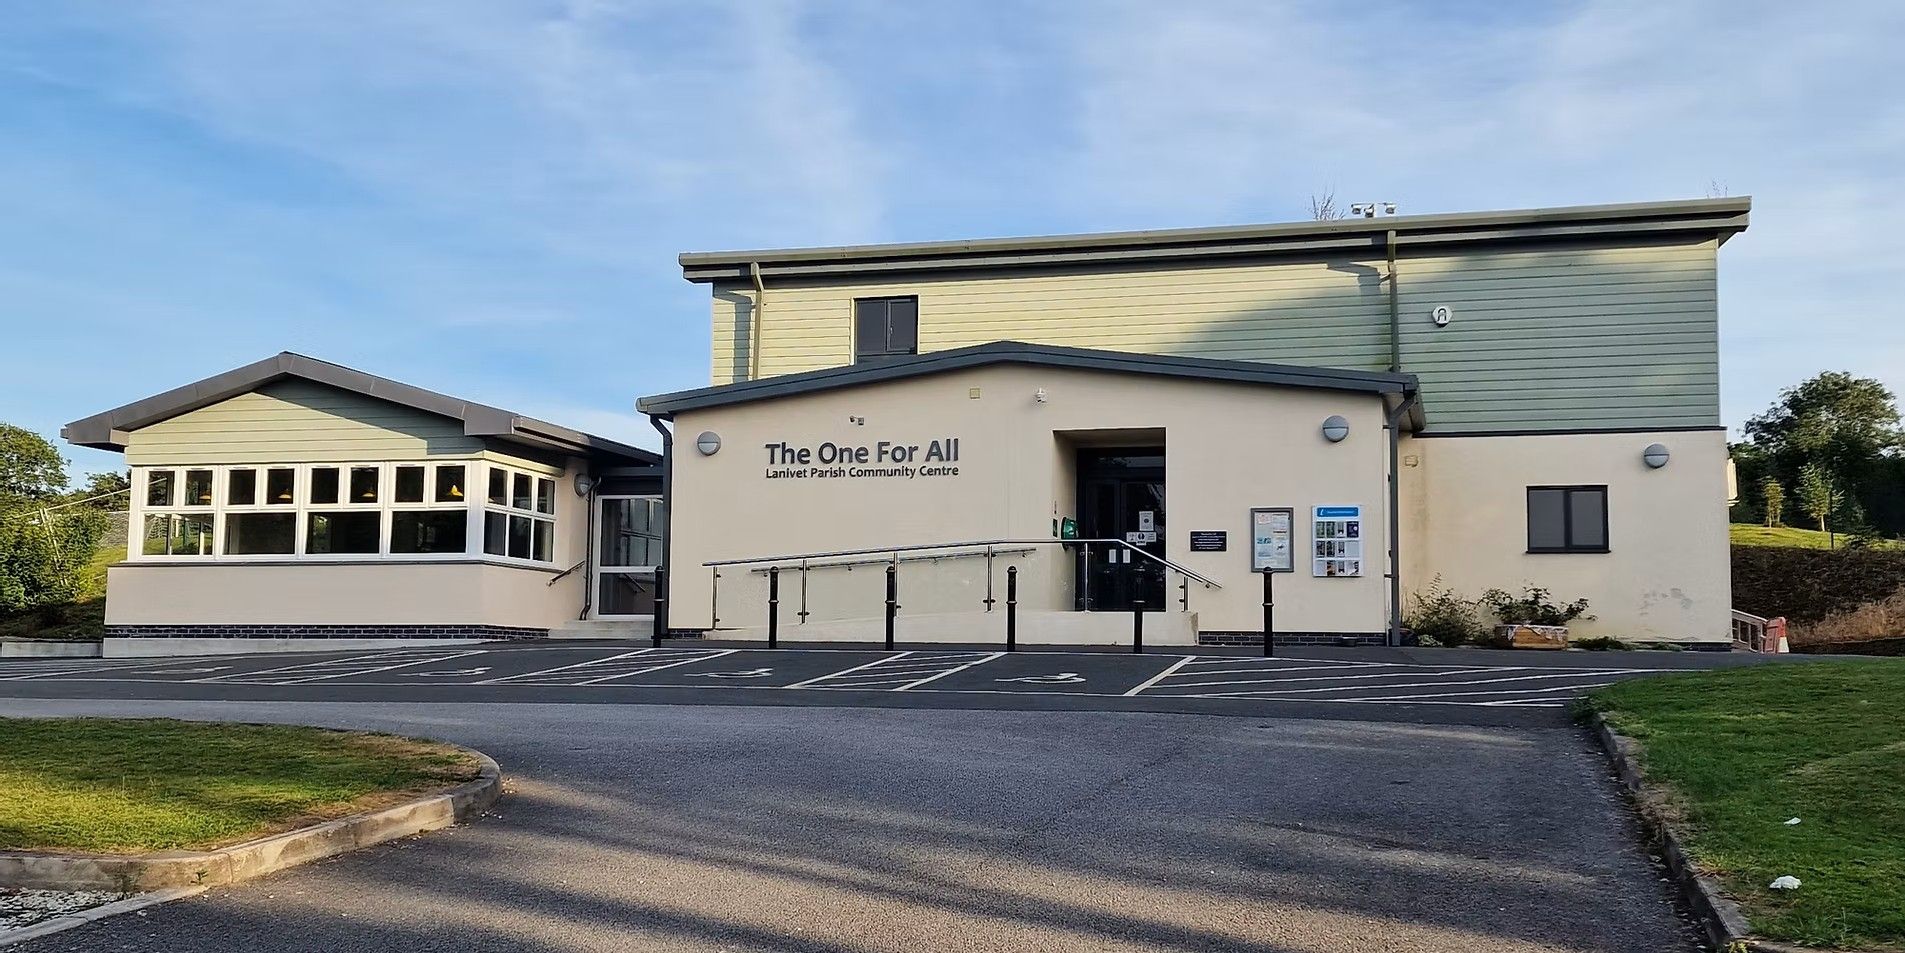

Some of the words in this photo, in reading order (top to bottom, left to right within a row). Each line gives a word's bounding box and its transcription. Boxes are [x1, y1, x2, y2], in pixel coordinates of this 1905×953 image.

[765, 442, 811, 465] The
[818, 442, 869, 465] One
[877, 441, 919, 463] For
[925, 438, 959, 462] All
[765, 467, 808, 479] Lanivet
[810, 466, 846, 478] Parish
[849, 465, 916, 479] Community
[919, 465, 959, 477] Centre
